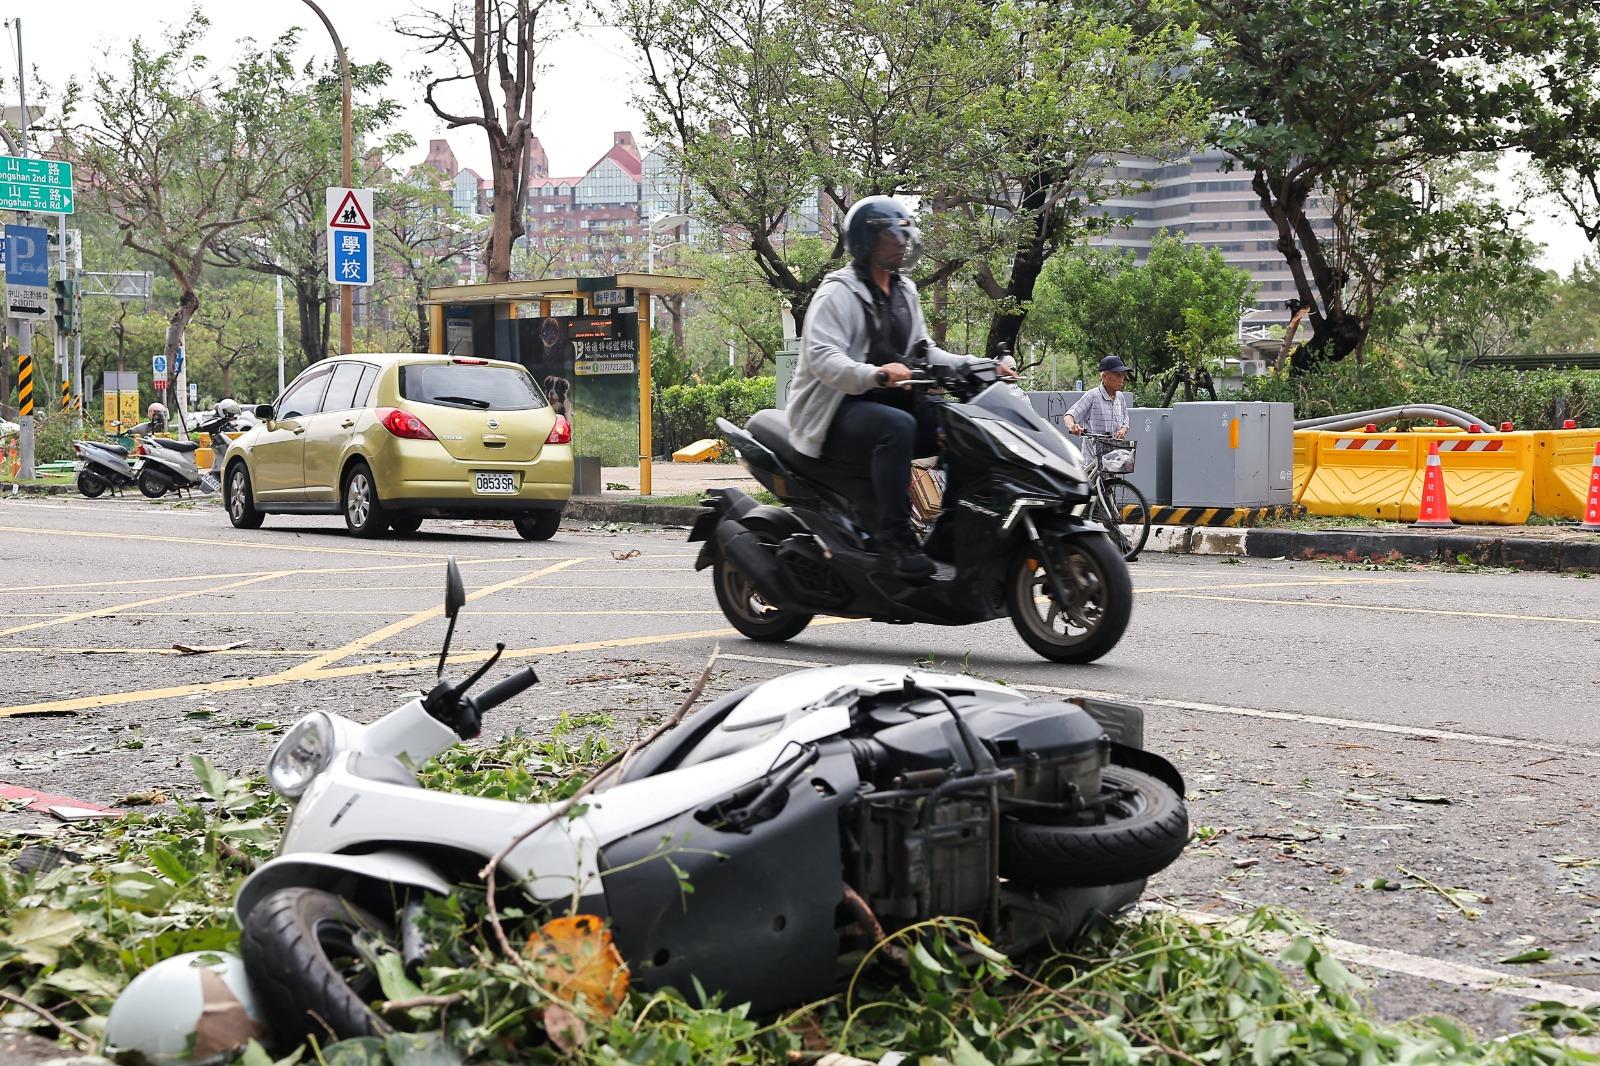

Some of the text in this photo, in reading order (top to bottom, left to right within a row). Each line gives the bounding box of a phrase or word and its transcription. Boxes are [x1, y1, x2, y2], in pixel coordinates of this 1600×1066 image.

[8, 158, 61, 176] 山二路
[32, 173, 46, 183] 2nd
[48, 175, 61, 185] Rd.
[9, 184, 62, 201] 山三路
[34, 199, 47, 209] 3rd
[50, 201, 62, 210] Rd.
[6, 234, 35, 275] P
[341, 235, 361, 279] 學校
[12, 299, 35, 307] 200m
